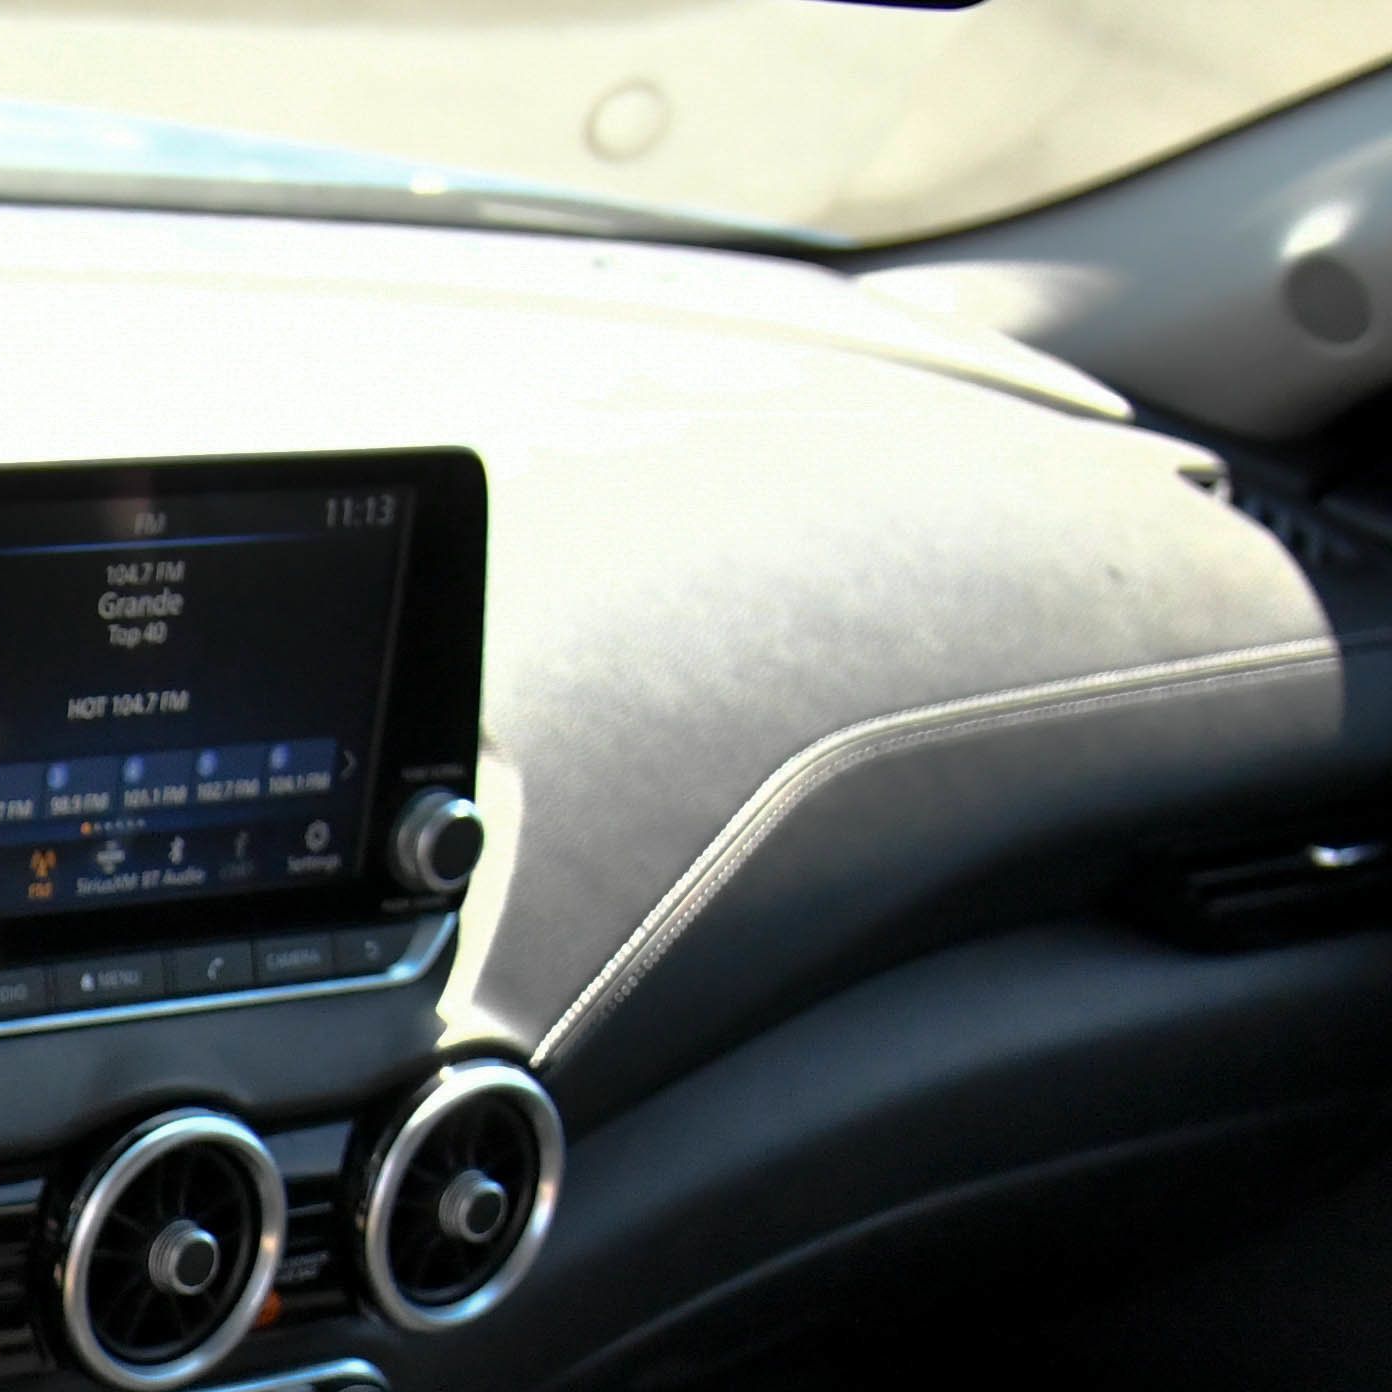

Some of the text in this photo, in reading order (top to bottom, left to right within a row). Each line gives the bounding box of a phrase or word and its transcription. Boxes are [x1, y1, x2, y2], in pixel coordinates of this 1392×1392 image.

[133, 512, 168, 535] FM
[323, 496, 395, 528] 11:13
[106, 560, 186, 586] 104.7 FM
[97, 588, 184, 620] Grande
[108, 621, 168, 649] Top 40
[67, 689, 190, 720] HOT 104.7 FM
[76, 870, 139, 896] SiriusXM
[162, 866, 206, 887] Audio
